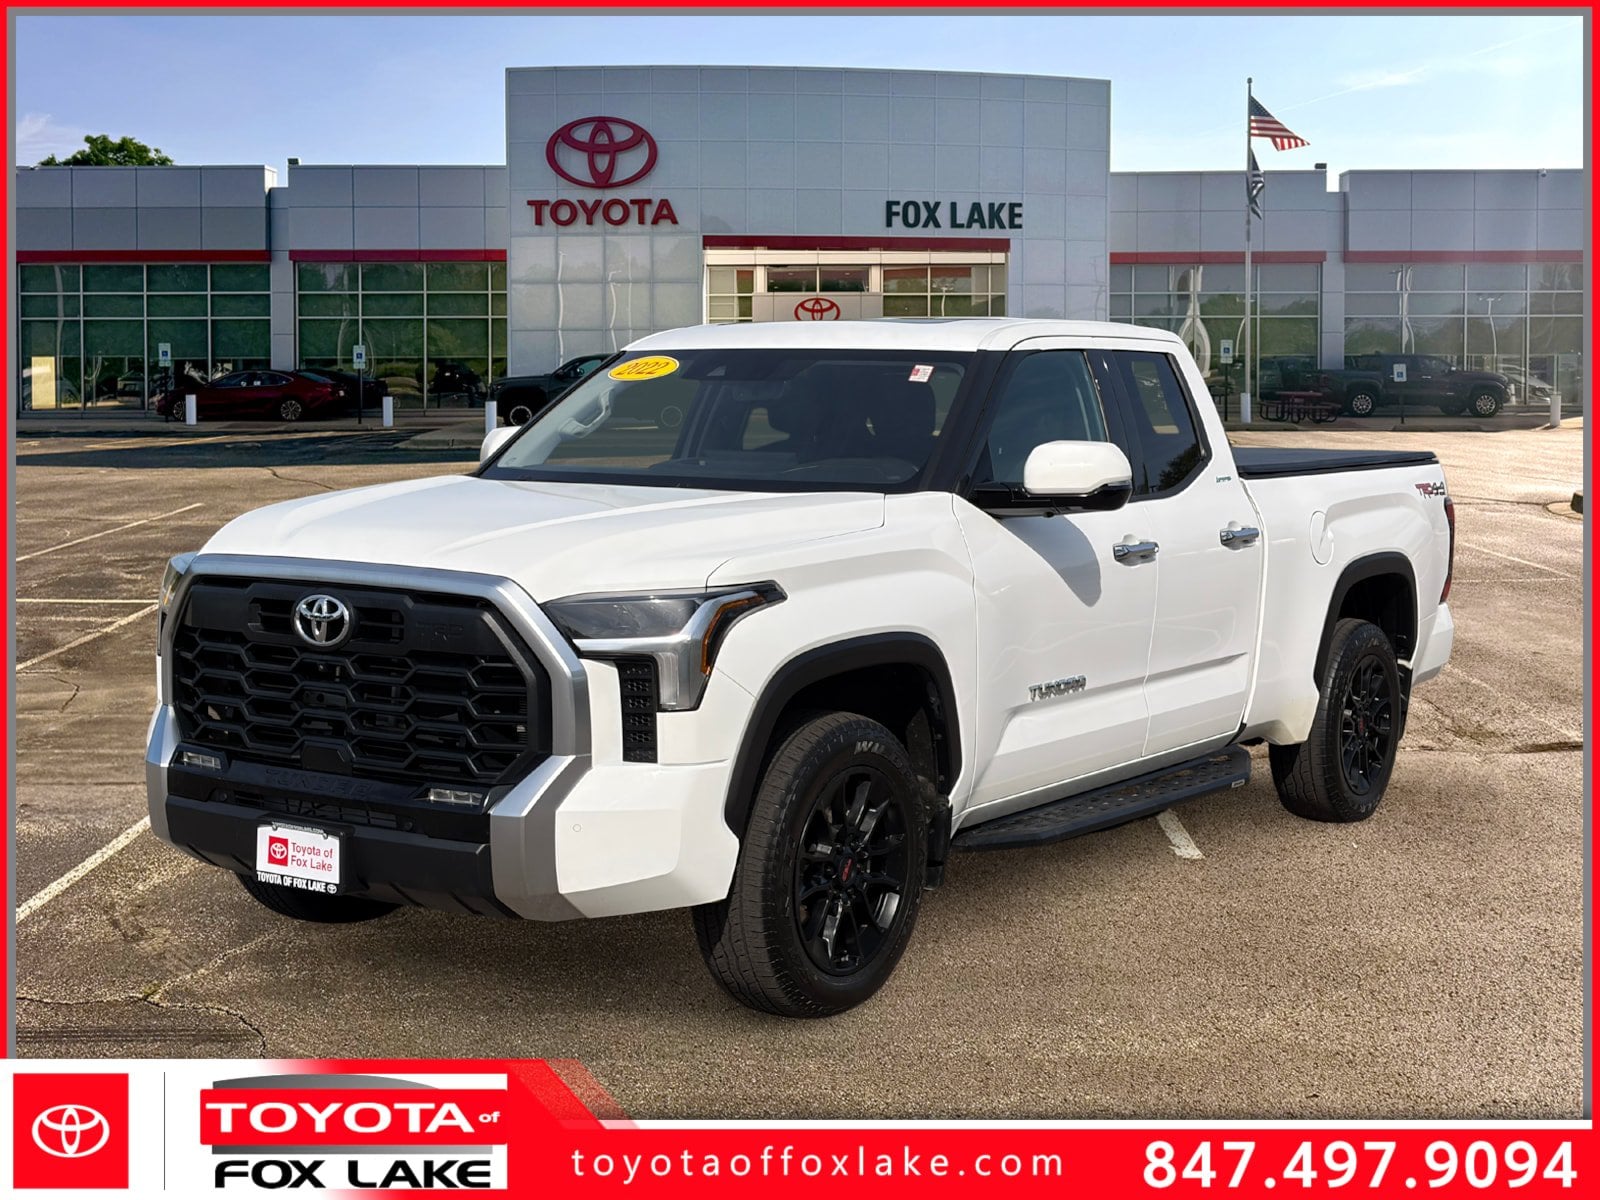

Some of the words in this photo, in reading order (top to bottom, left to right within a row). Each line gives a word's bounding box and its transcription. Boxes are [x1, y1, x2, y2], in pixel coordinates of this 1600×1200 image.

[527, 198, 679, 227] TOYOTA
[884, 200, 942, 229] FOX
[949, 201, 1024, 230] LAKE
[615, 361, 670, 376] 2022
[1028, 674, 1087, 702] TUNDRA
[291, 842, 321, 857] Toyota
[323, 848, 333, 859] of
[290, 854, 308, 868] Fox
[310, 858, 333, 873] Lake
[256, 871, 282, 886] TOYOTA
[282, 876, 293, 888] OF
[292, 878, 307, 890] FOX
[307, 881, 326, 893] LAKE
